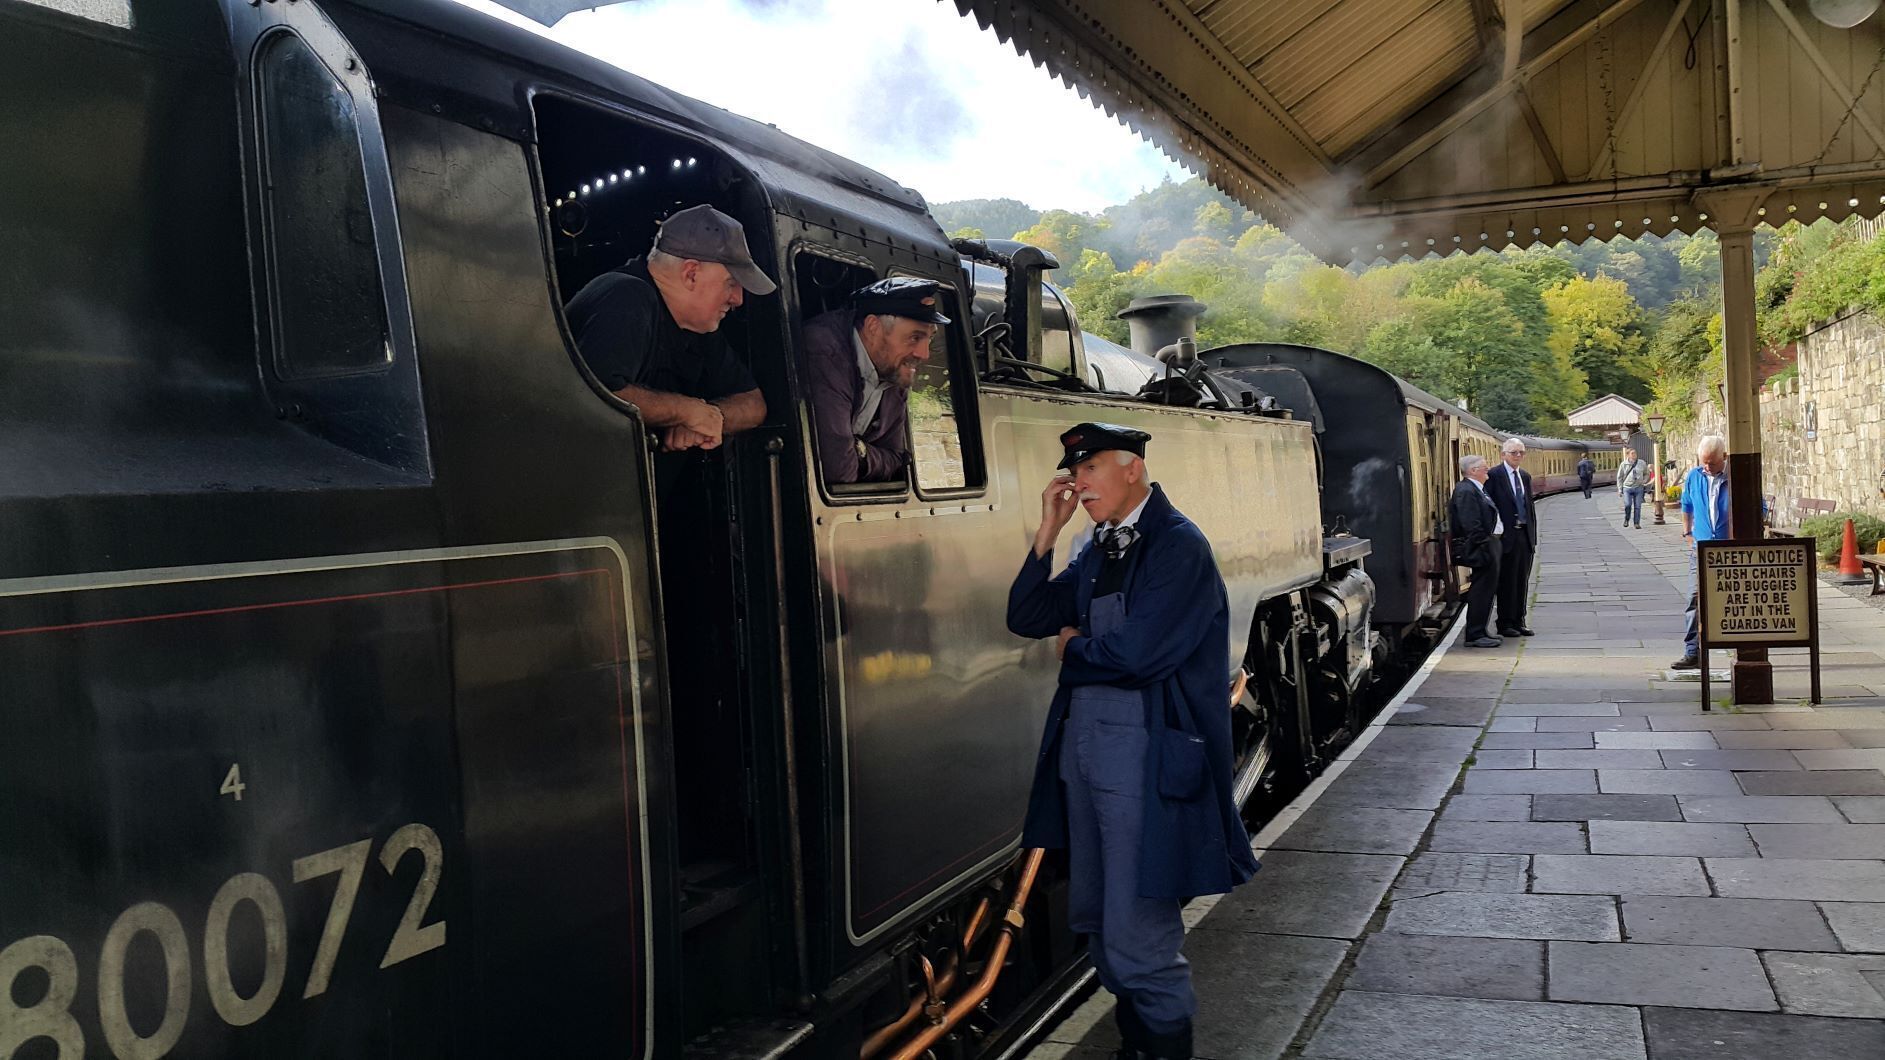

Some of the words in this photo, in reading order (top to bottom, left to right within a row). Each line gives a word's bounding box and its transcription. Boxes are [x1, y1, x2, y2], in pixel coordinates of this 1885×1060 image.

[1707, 551, 1753, 565] SAFETY
[1759, 550, 1803, 563] NOTICE
[1717, 569, 1747, 579] PUSH
[1752, 568, 1795, 579] CHAIRS
[1717, 581, 1740, 592] AND
[1745, 580, 1796, 591] BUGGIES
[1727, 593, 1749, 604] ARE
[1754, 593, 1768, 603] TO
[1773, 592, 1787, 603] BE
[1725, 606, 1746, 617] PUT
[1752, 606, 1763, 616] IN
[1767, 605, 1790, 615] THE
[1721, 619, 1768, 630] GUARDS
[1772, 618, 1795, 628] VAN
[219, 763, 246, 801] 4
[0, 822, 447, 1060] 80072
